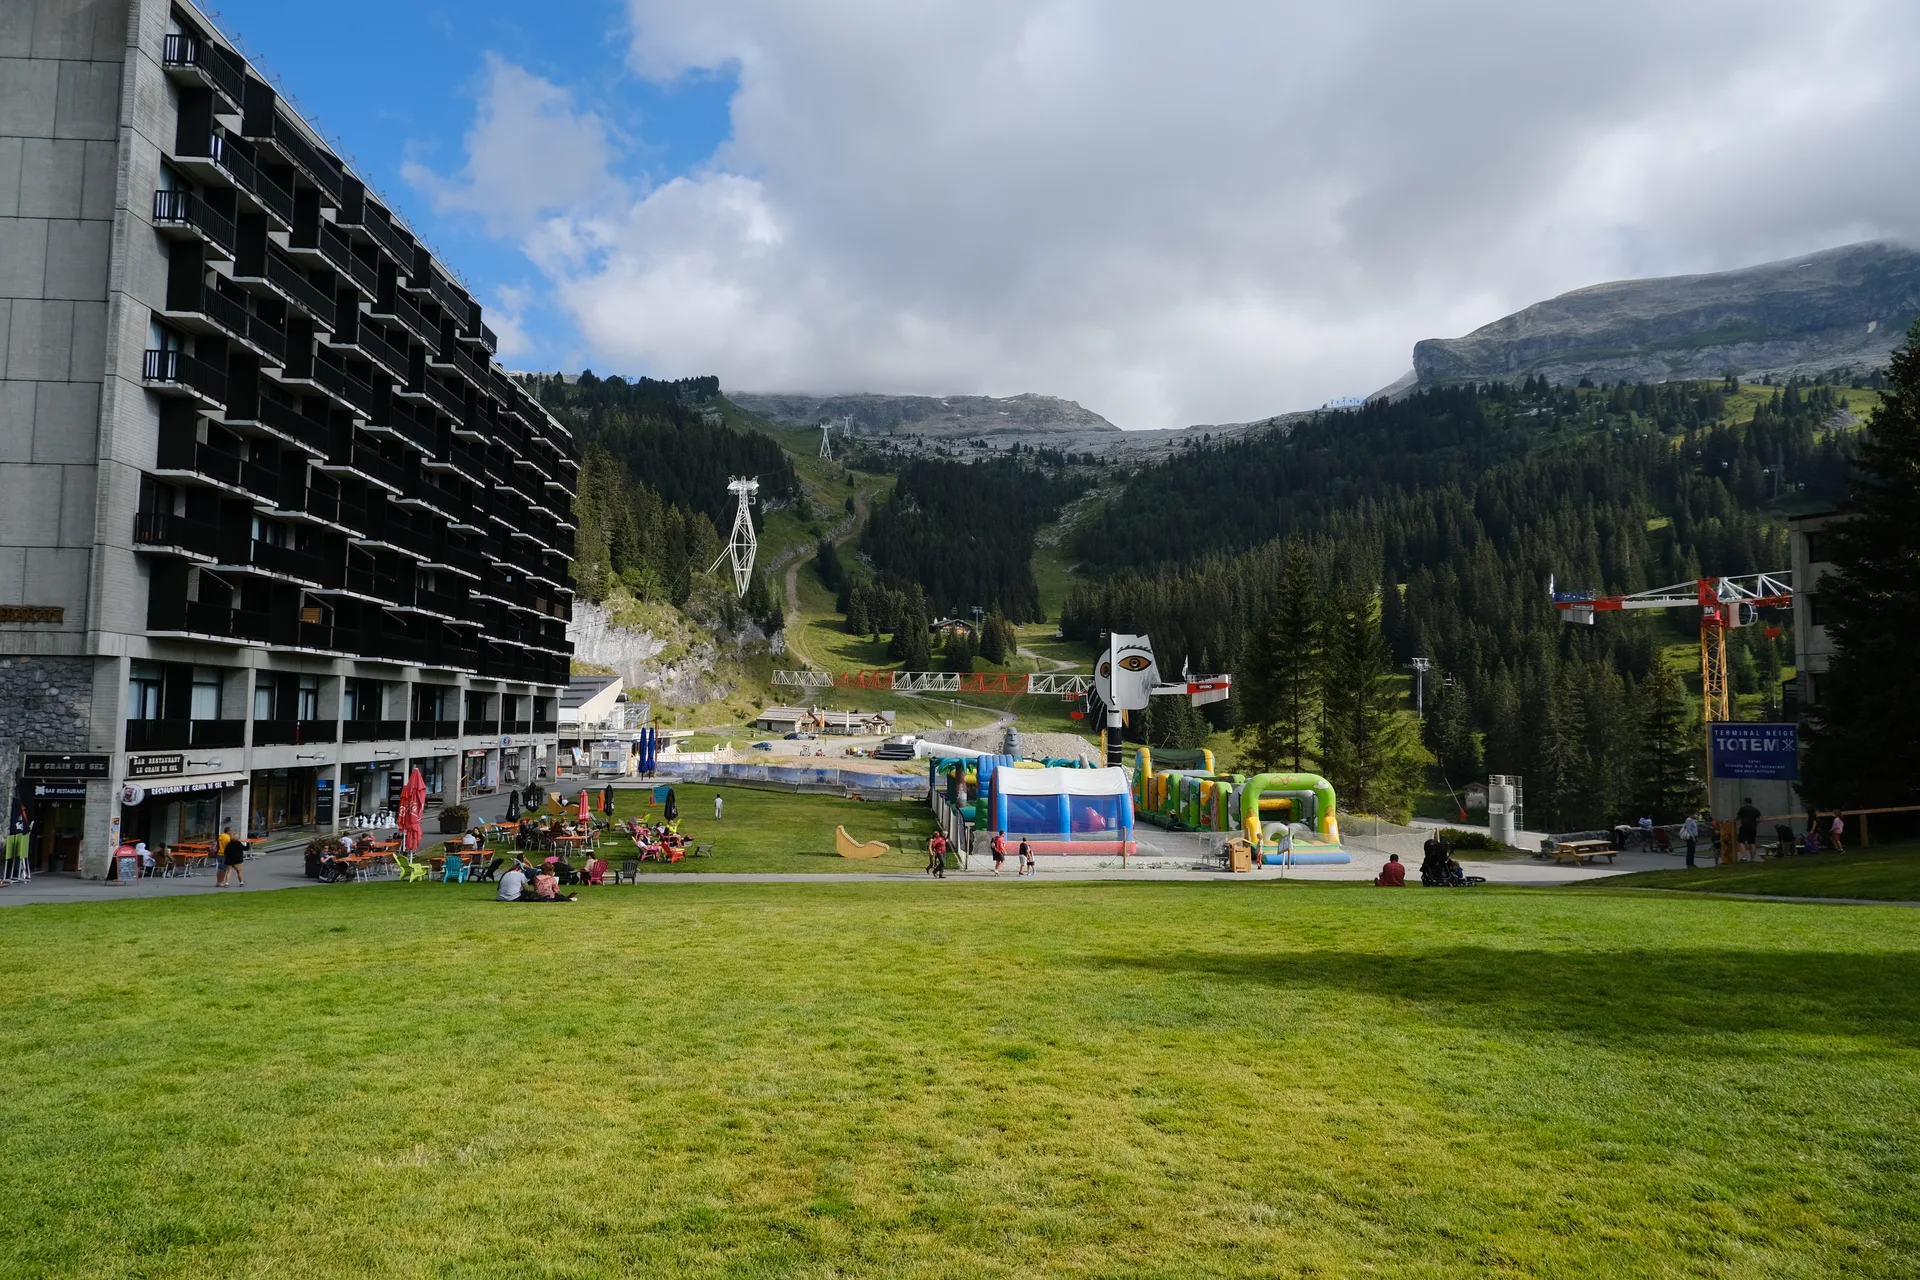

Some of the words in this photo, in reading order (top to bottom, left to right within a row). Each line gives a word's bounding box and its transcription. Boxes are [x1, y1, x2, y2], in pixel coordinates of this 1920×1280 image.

[1714, 729, 1760, 737] TERMINAL
[1716, 738, 1780, 752] TOTEM
[29, 762, 41, 770] LE
[133, 758, 145, 766] BAR
[148, 756, 181, 765] RESTAURANT
[135, 766, 143, 774] LE
[144, 765, 160, 773] GRAIN
[169, 764, 178, 772] SEL
[151, 785, 184, 795] RESTAURANT
[184, 784, 190, 793] LE
